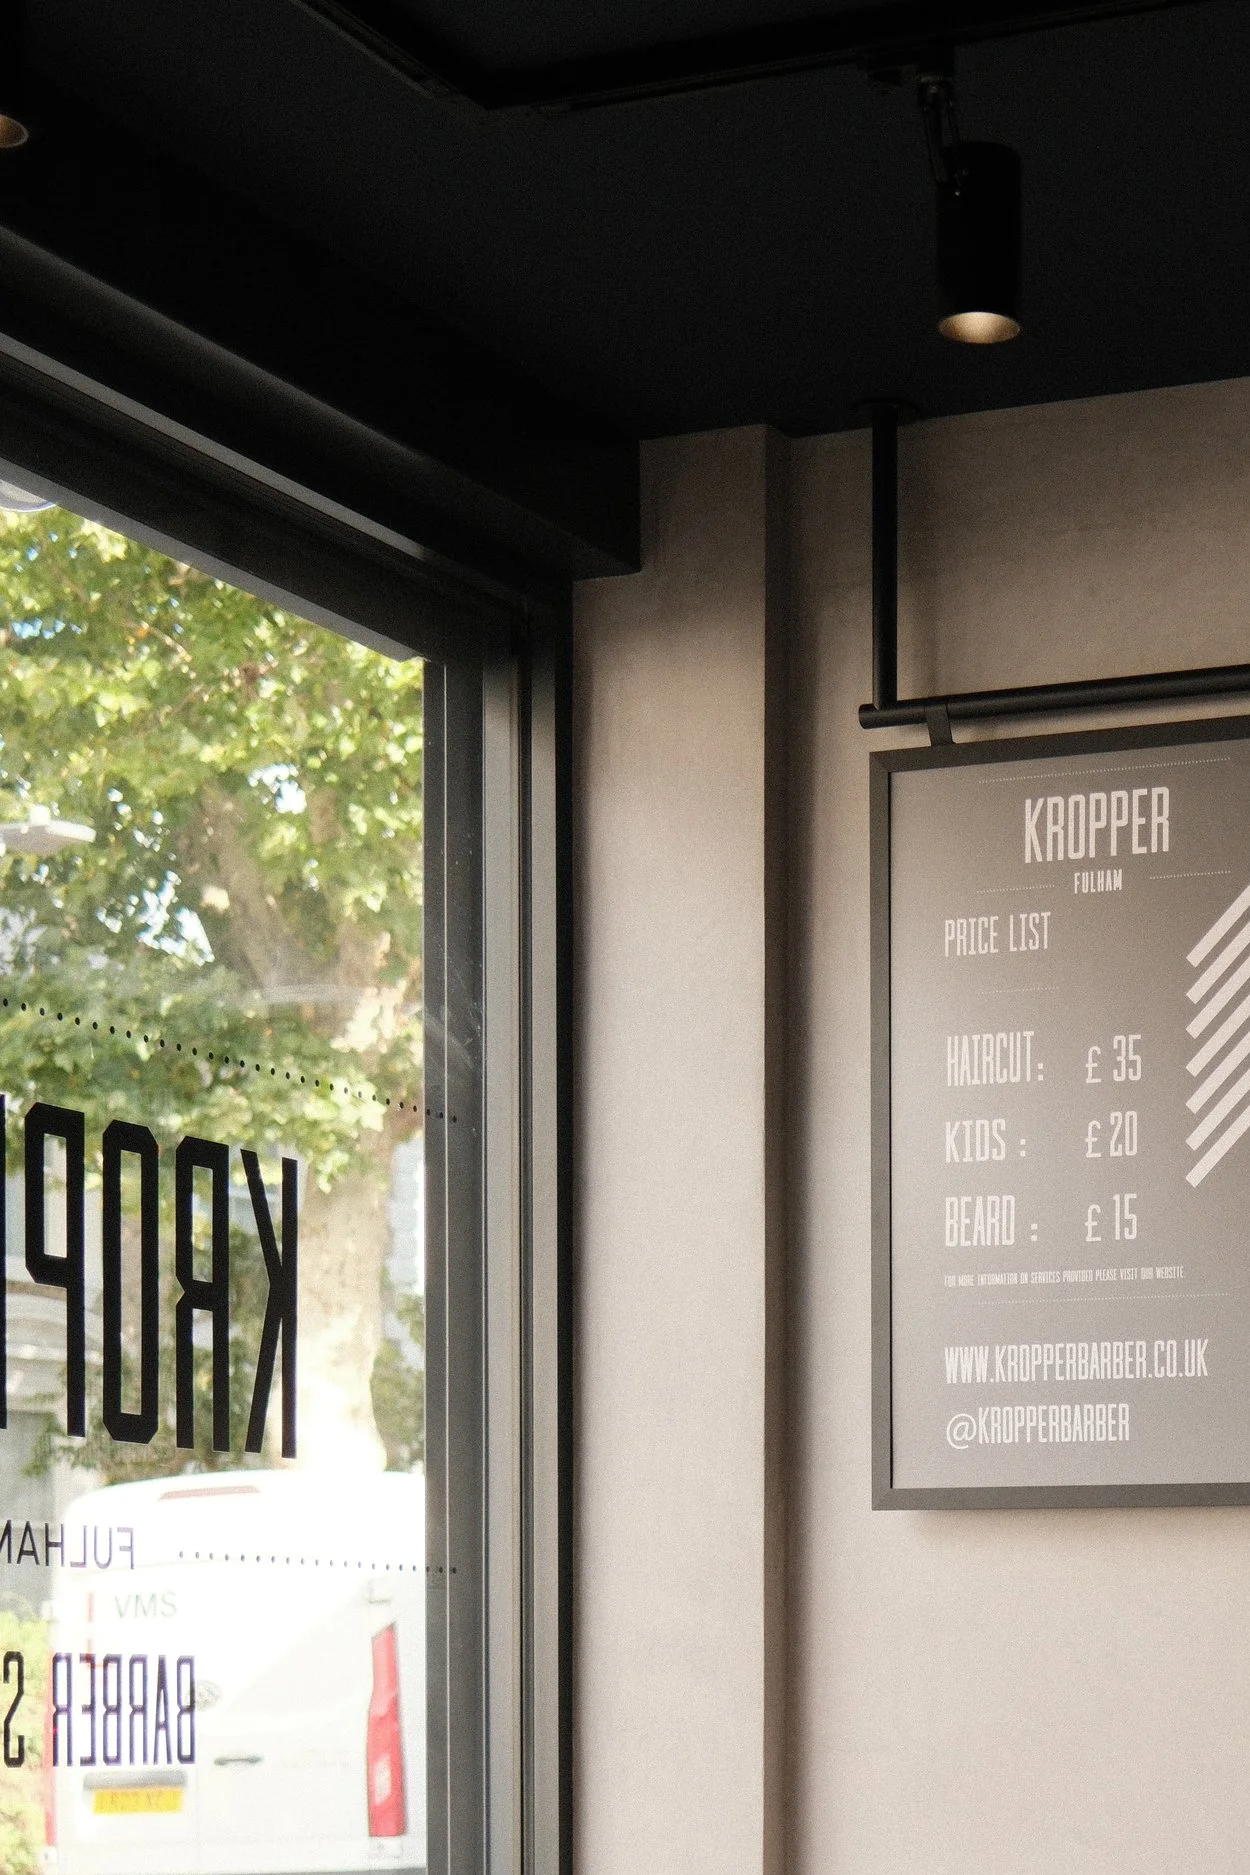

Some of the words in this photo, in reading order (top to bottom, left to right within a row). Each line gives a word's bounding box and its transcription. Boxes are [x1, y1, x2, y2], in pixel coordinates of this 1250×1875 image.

[1024, 785, 1171, 864] KROPPER
[1073, 868, 1123, 895] FULHAM
[944, 915, 999, 958] PRICE
[1008, 910, 1052, 953] LIST
[946, 1030, 1044, 1086] HAIRCUT:
[958, 1275, 974, 1287] MORE
[977, 1273, 1018, 1285] INFORMATION
[1020, 1272, 1029, 1285] ON
[1030, 1271, 1061, 1283] SERVICES
[1062, 1270, 1093, 1282] PROVIDED
[1095, 1268, 1118, 1281] PLEASE
[1119, 1267, 1138, 1280] VISIT
[1140, 1266, 1154, 1279] OUR
[944, 1338, 1210, 1385] WWW.KROPPERBARBER.CO.UK
[945, 1402, 1130, 1450] @KROPPERBARBER
[114, 1590, 178, 1620] VMS
